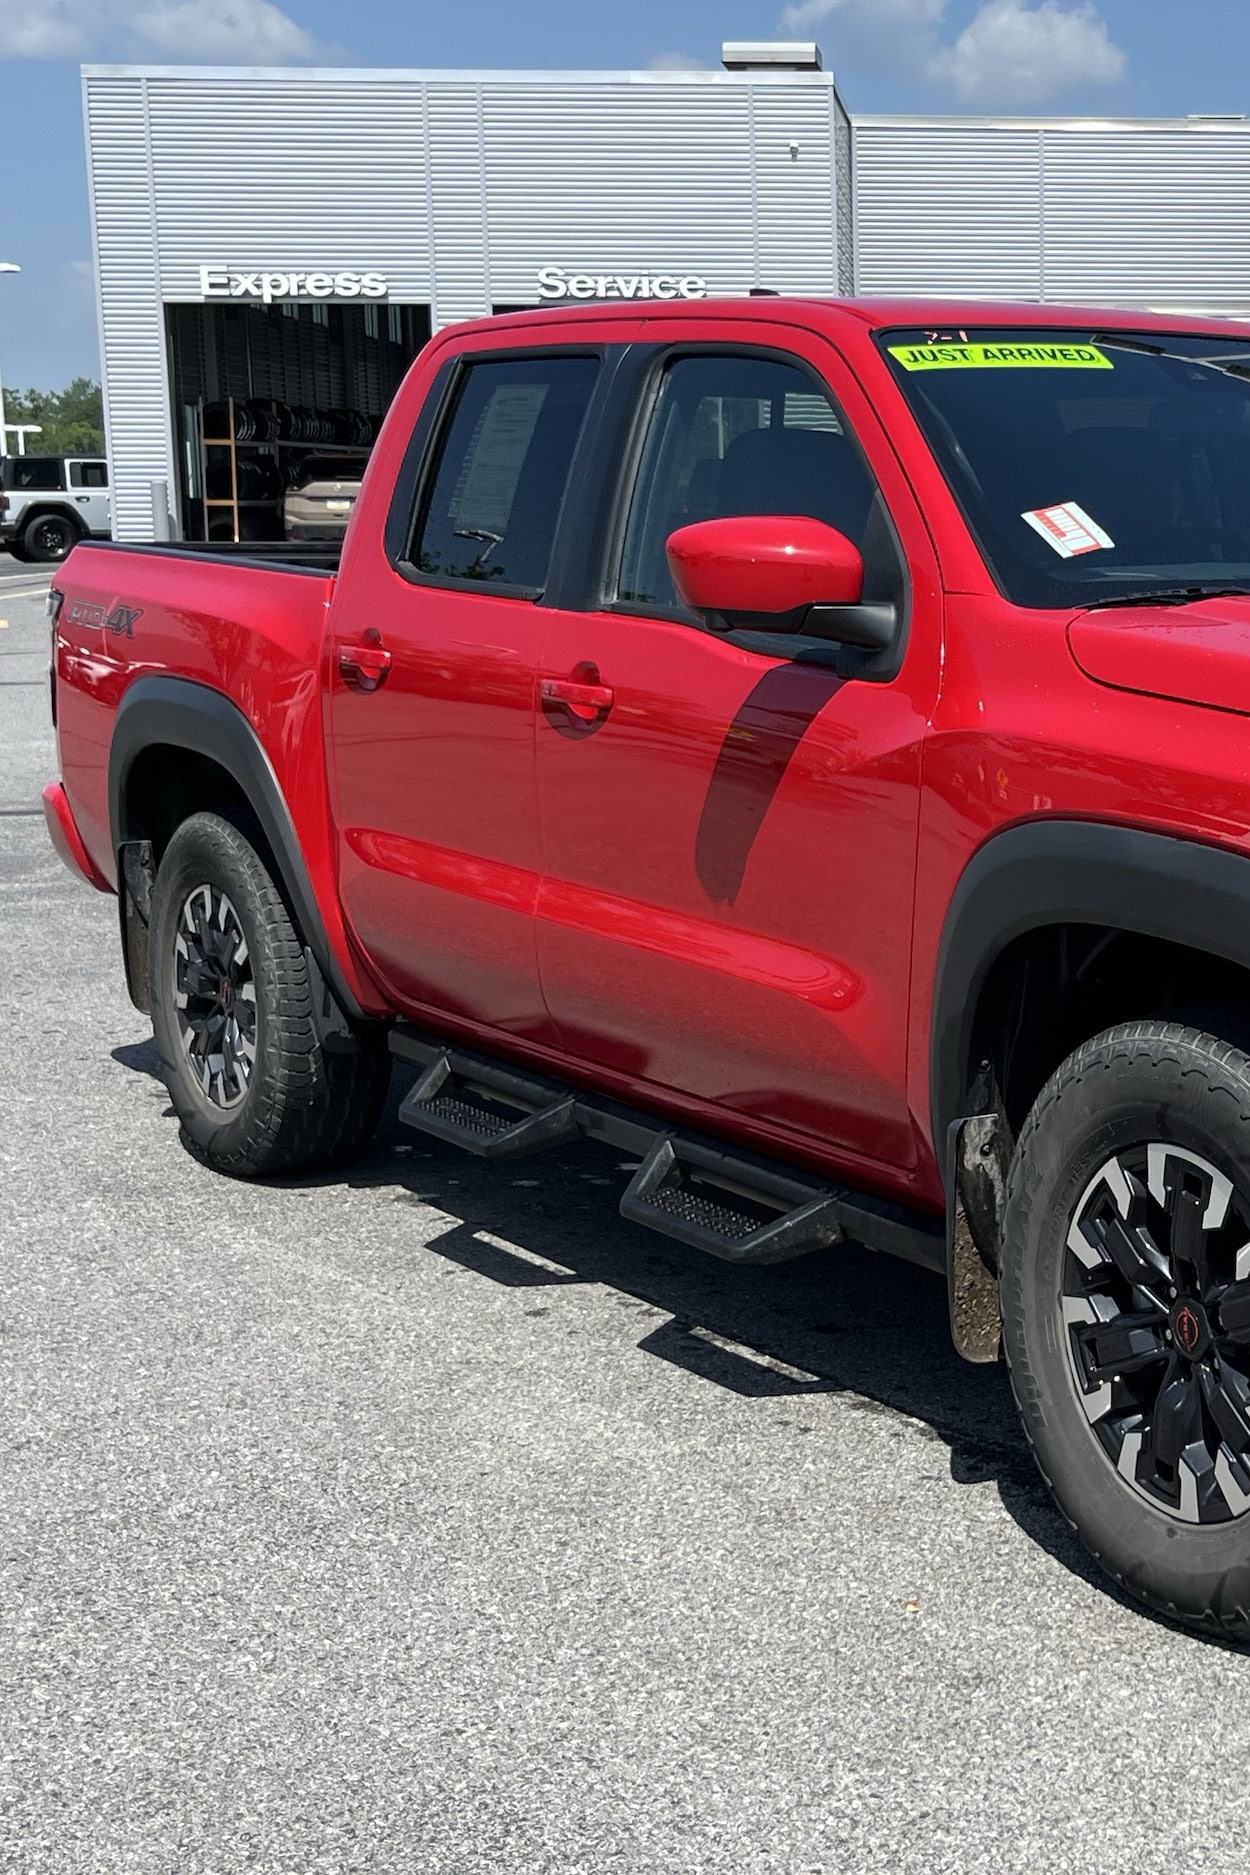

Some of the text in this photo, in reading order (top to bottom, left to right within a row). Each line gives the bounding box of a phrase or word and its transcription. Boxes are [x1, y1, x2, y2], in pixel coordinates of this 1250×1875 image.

[199, 265, 388, 304] Express
[537, 267, 706, 299] Service
[906, 348, 1097, 363] JUST ARRIVED
